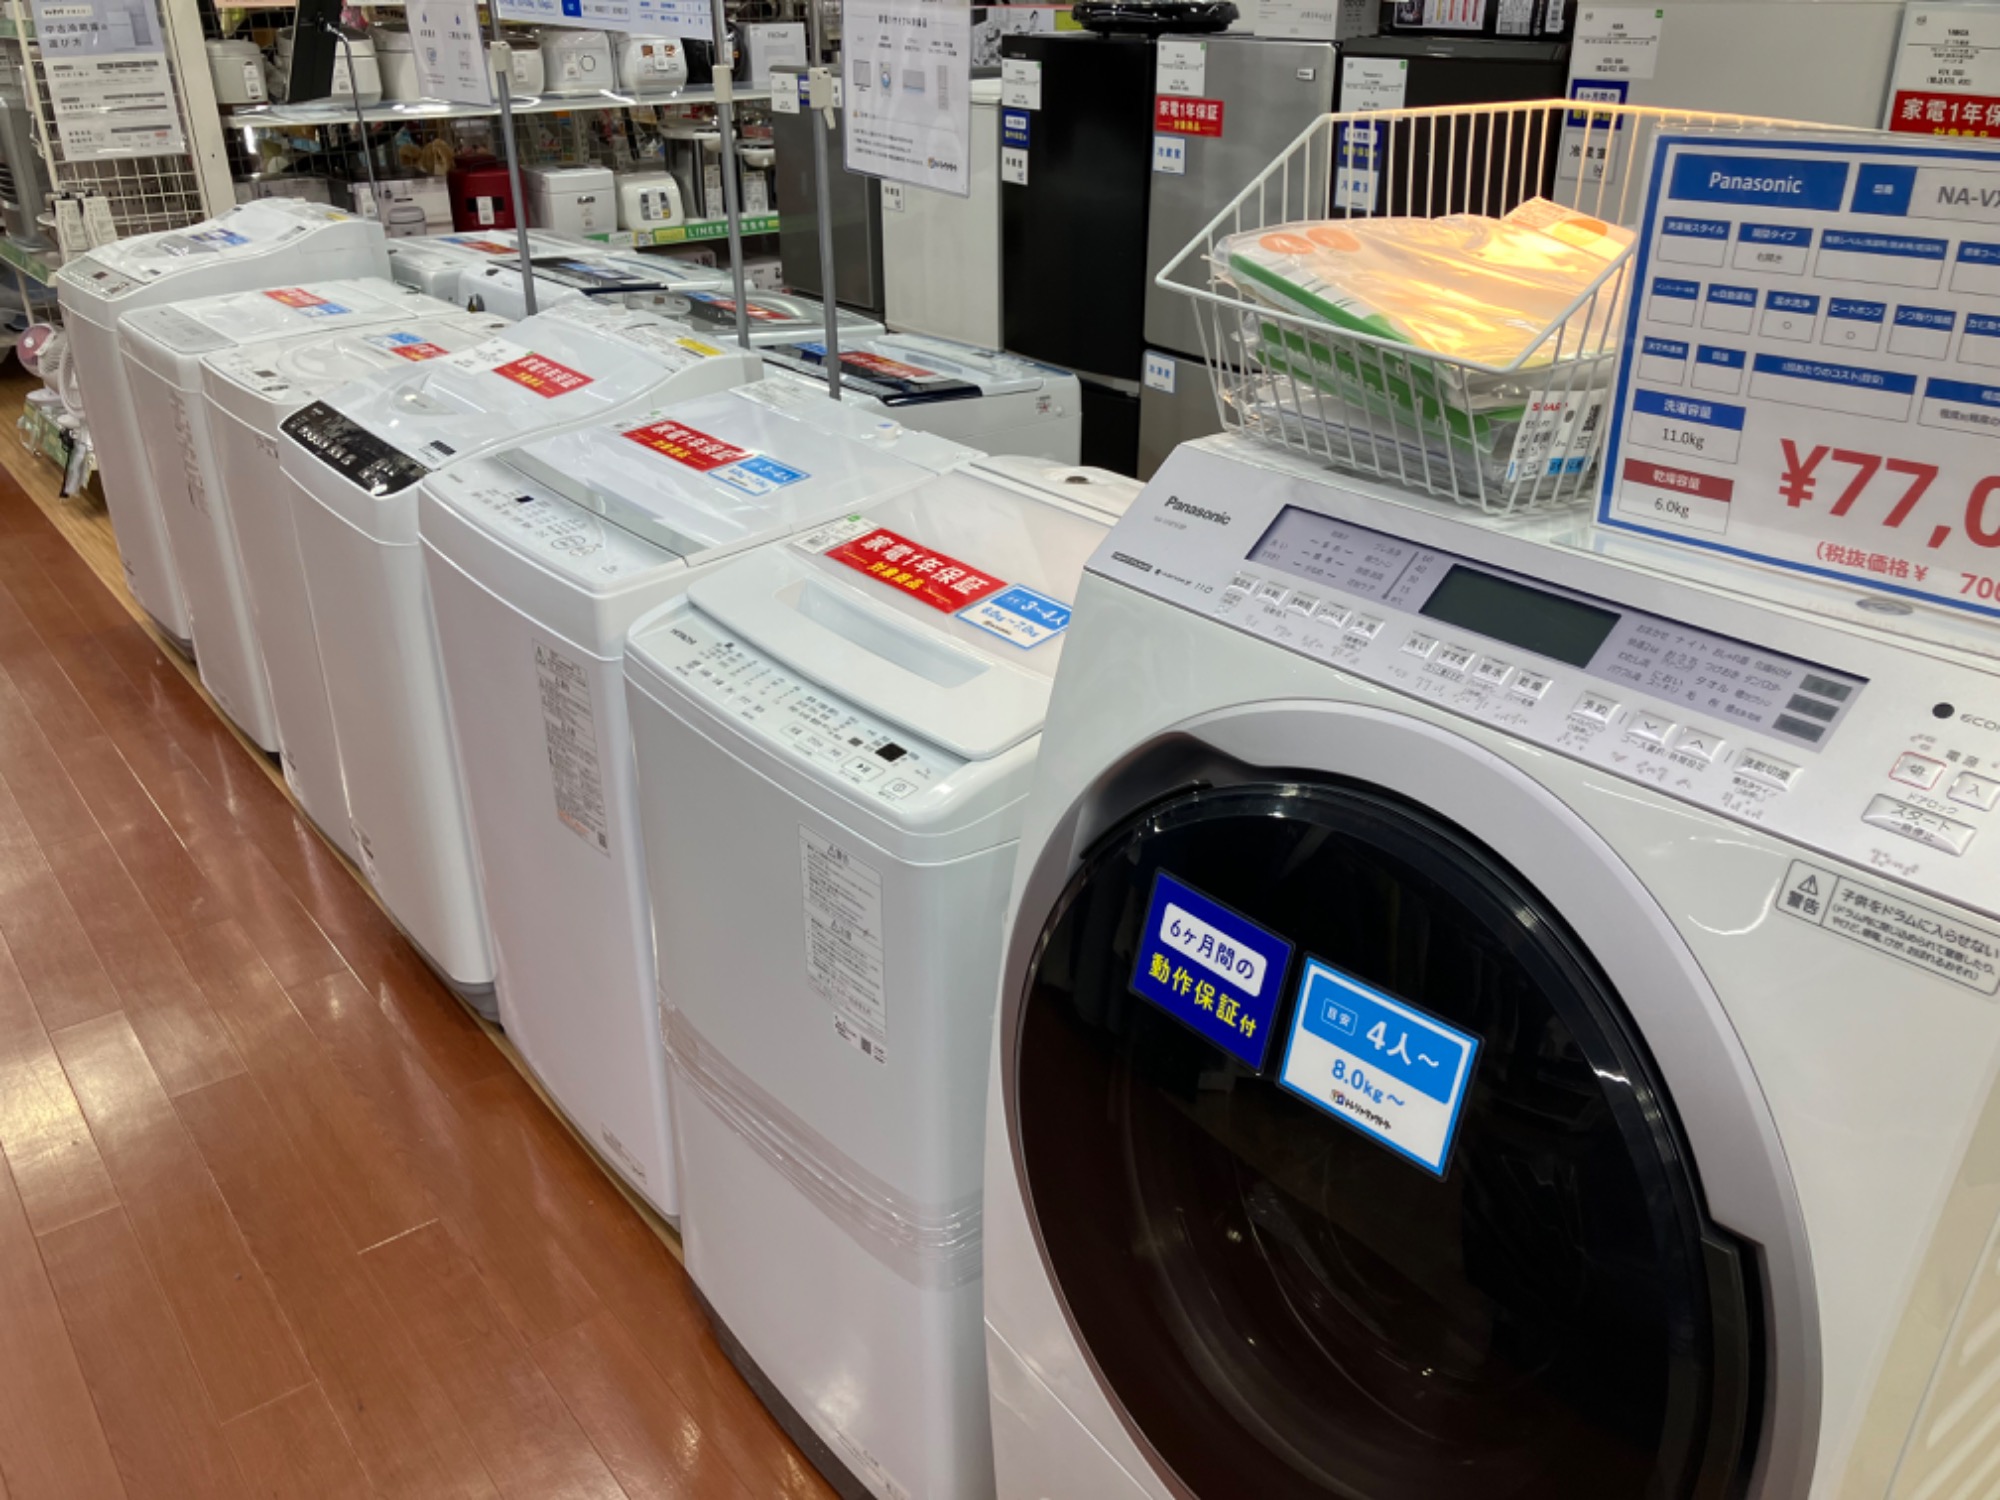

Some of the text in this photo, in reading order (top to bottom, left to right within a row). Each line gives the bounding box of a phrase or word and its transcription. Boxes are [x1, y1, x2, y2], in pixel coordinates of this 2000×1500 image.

[1708, 171, 1803, 194] Panasonic
[1830, 303, 1883, 317] ヒートポンプ
[1663, 398, 1712, 419] 洗濯容量
[1662, 427, 1705, 451] 11.0kg
[1652, 469, 1701, 491] 乾燥容量
[1165, 495, 1231, 525] Panasonic
[1654, 497, 1690, 519] 6.0kg
[860, 534, 991, 597] 家電1年保証
[1959, 713, 2000, 733] ECO
[1965, 782, 1981, 798] 入
[1907, 791, 1959, 815] ドアロック
[1787, 890, 1821, 916] 警告
[1840, 887, 2000, 959] 子供をドラムに入らせない
[1169, 918, 1255, 980] 6ヶ月間の
[1148, 951, 1257, 1039] 動作保証付
[1326, 1005, 1352, 1028] 目安
